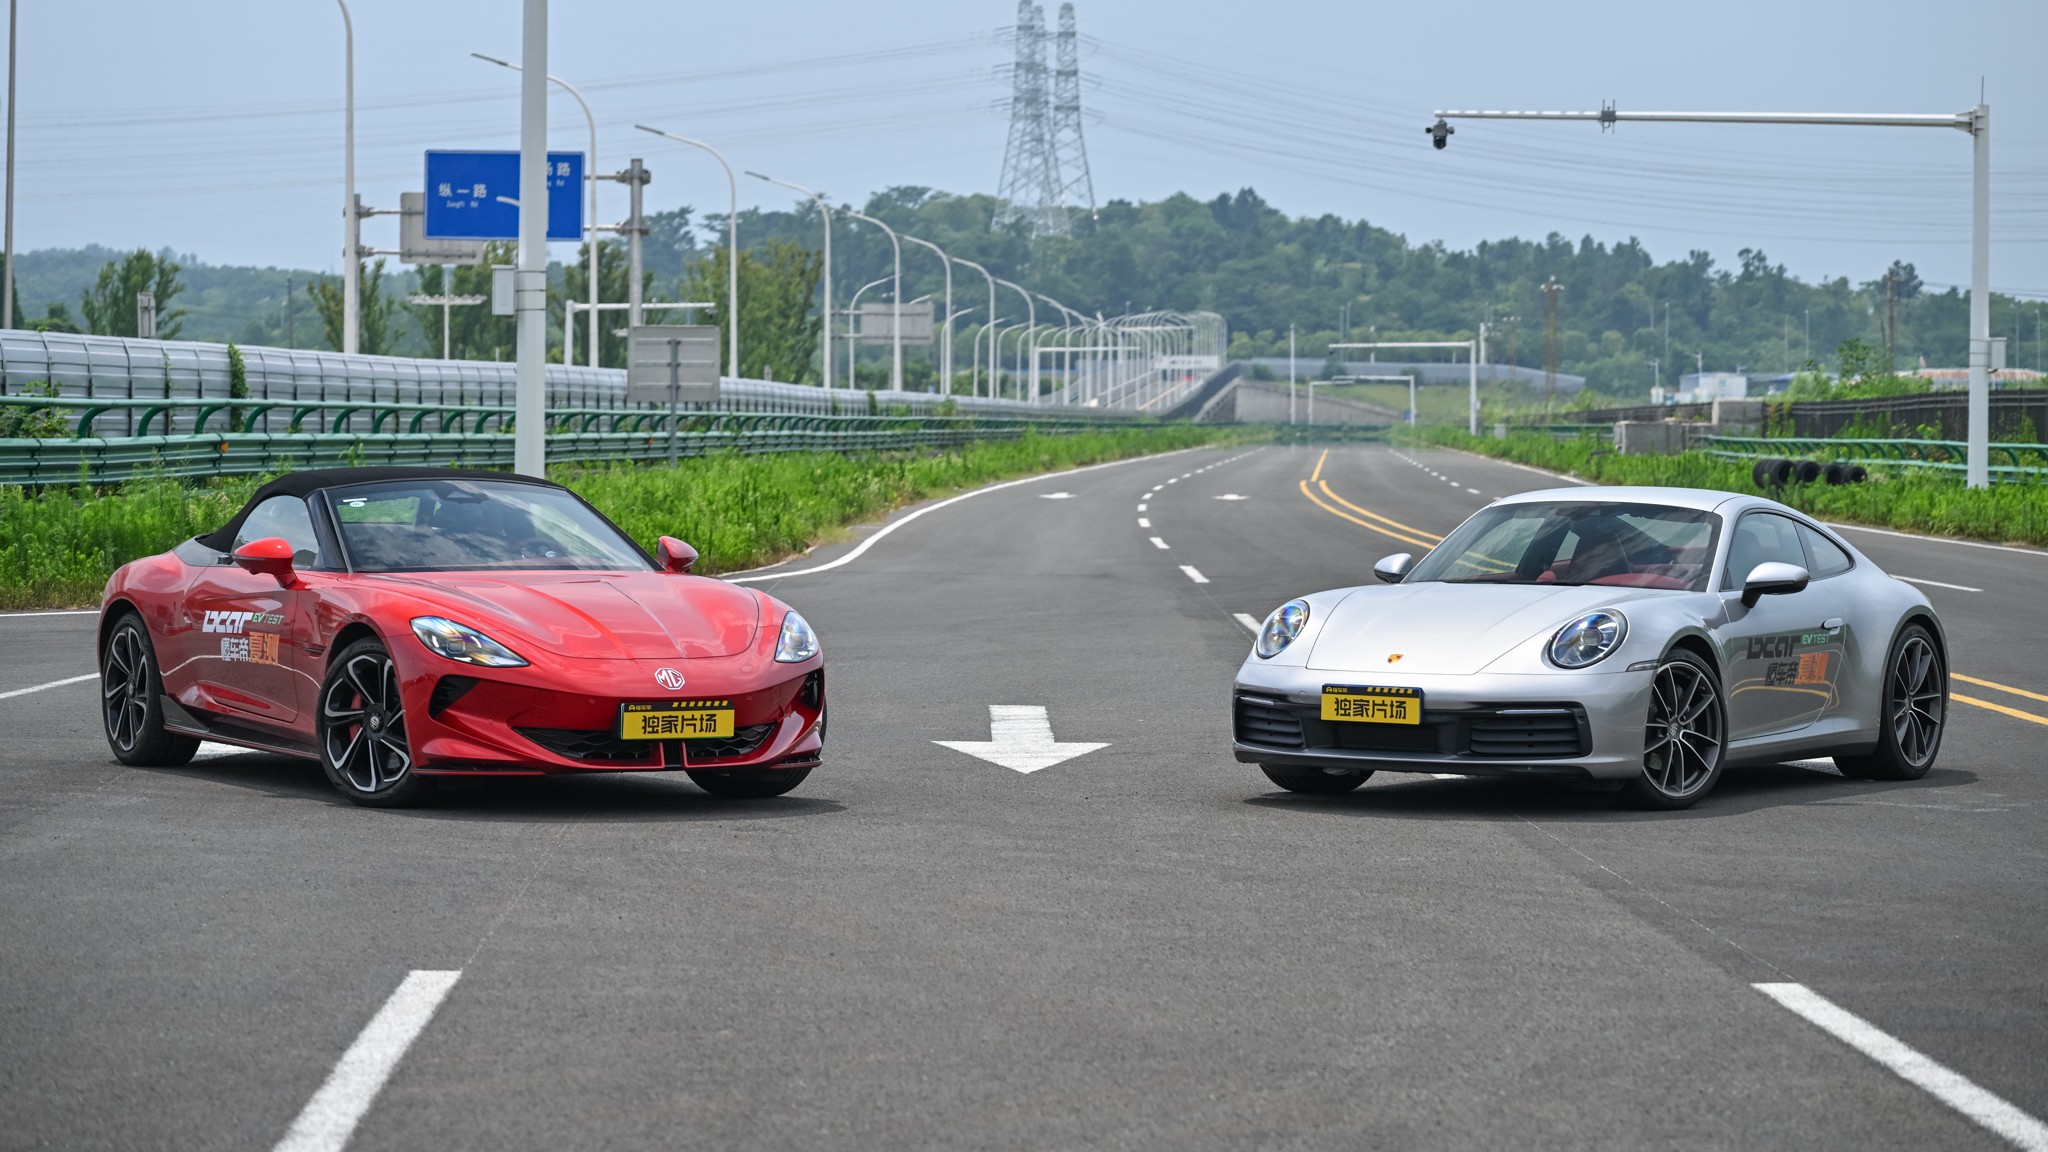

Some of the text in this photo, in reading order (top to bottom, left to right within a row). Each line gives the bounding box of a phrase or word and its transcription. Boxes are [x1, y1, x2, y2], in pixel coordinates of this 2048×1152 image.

[656, 669, 684, 689] MG
[1334, 697, 1407, 720] 独家片场
[641, 713, 717, 735] 独家片场
